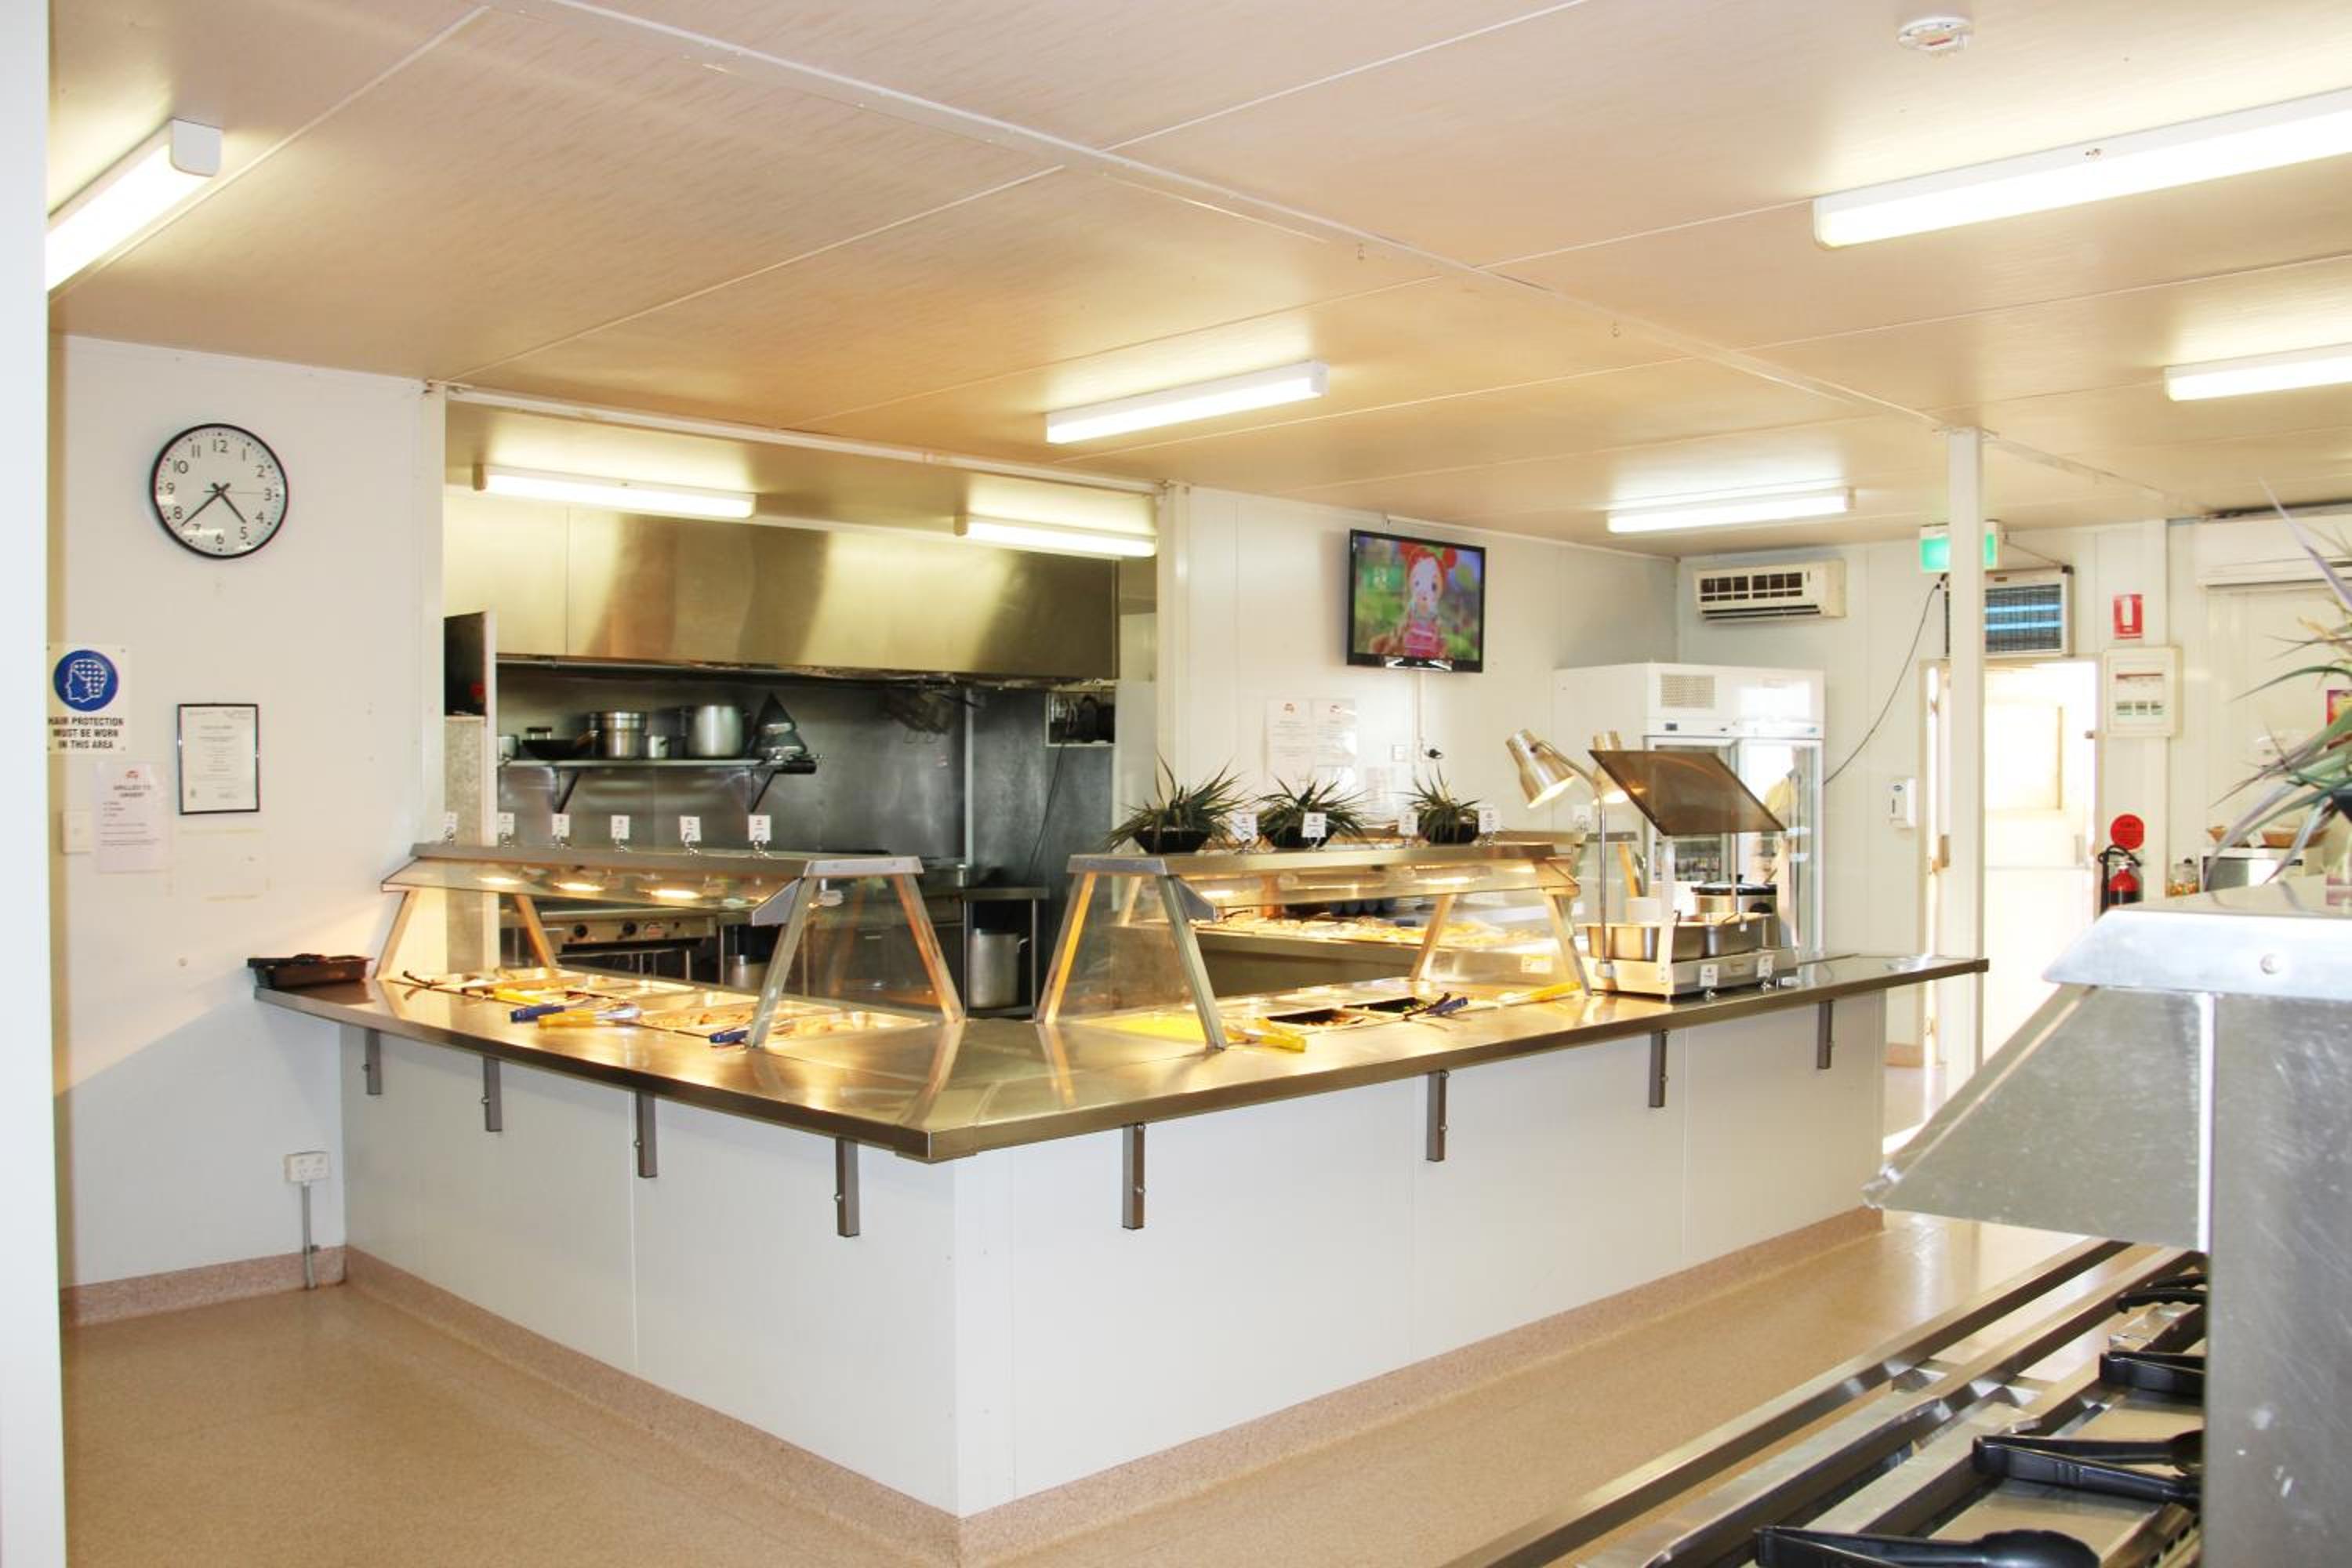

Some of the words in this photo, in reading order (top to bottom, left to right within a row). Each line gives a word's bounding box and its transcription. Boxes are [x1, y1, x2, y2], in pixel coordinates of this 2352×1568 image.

[191, 444, 201, 459] 11
[212, 439, 228, 453] 12
[241, 448, 246, 462] 1
[172, 460, 189, 474] 10
[255, 464, 265, 477] 2
[165, 482, 175, 495] 9
[264, 488, 272, 501] 3
[173, 506, 183, 520] 8
[256, 511, 264, 524] 4
[240, 526, 248, 539] 5
[215, 534, 225, 545] 6
[71, 717, 124, 726] PROTECTION
[53, 728, 78, 737] MUST
[80, 728, 91, 737] BE
[71, 740, 89, 749] THIS
[92, 740, 113, 749] AREA
